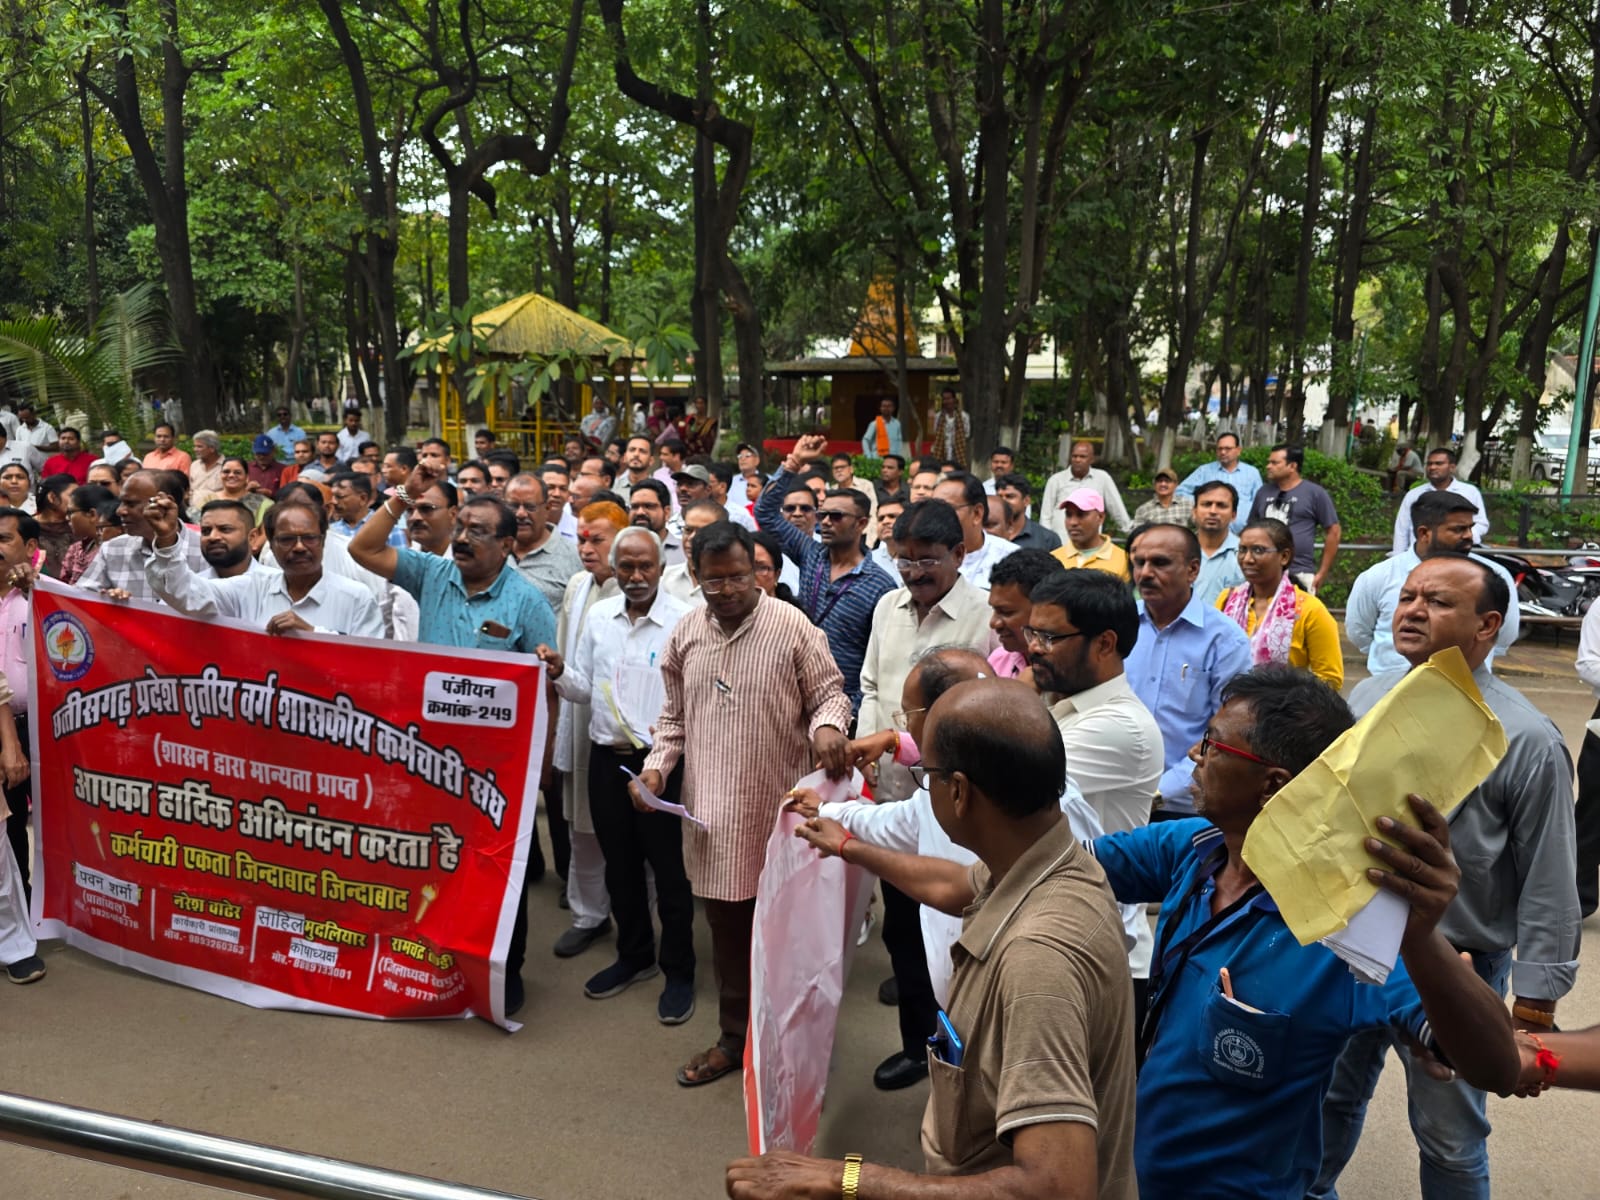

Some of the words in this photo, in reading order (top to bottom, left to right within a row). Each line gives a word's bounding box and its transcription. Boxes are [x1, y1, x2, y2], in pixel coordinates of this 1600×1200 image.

[441, 676, 496, 698] पंजीयन
[427, 699, 512, 721] क्रमांक-249
[135, 667, 179, 716] प्रदेश
[180, 667, 238, 727] तृतीय
[240, 673, 276, 726] वर्ग
[278, 688, 375, 753] शासकीय
[376, 721, 465, 796] कर्मचारी
[468, 771, 507, 829] संघ
[213, 751, 247, 779] द्वारा
[249, 761, 312, 792] मान्यता
[74, 767, 152, 814] आपका
[158, 780, 233, 828] हार्दिक
[239, 799, 354, 856] अभिनंदन
[358, 826, 432, 867] करता
[433, 825, 463, 870] है
[79, 870, 104, 889] पवन
[109, 882, 132, 901] शर्मा
[110, 831, 179, 866] कर्मचारी
[183, 846, 231, 876] एकता
[235, 851, 317, 896] जिन्दाबाद
[321, 870, 409, 911] जिन्दाबाद
[173, 891, 204, 912] नरेश
[257, 909, 304, 934] साहिल
[304, 920, 368, 947] मुदलियार
